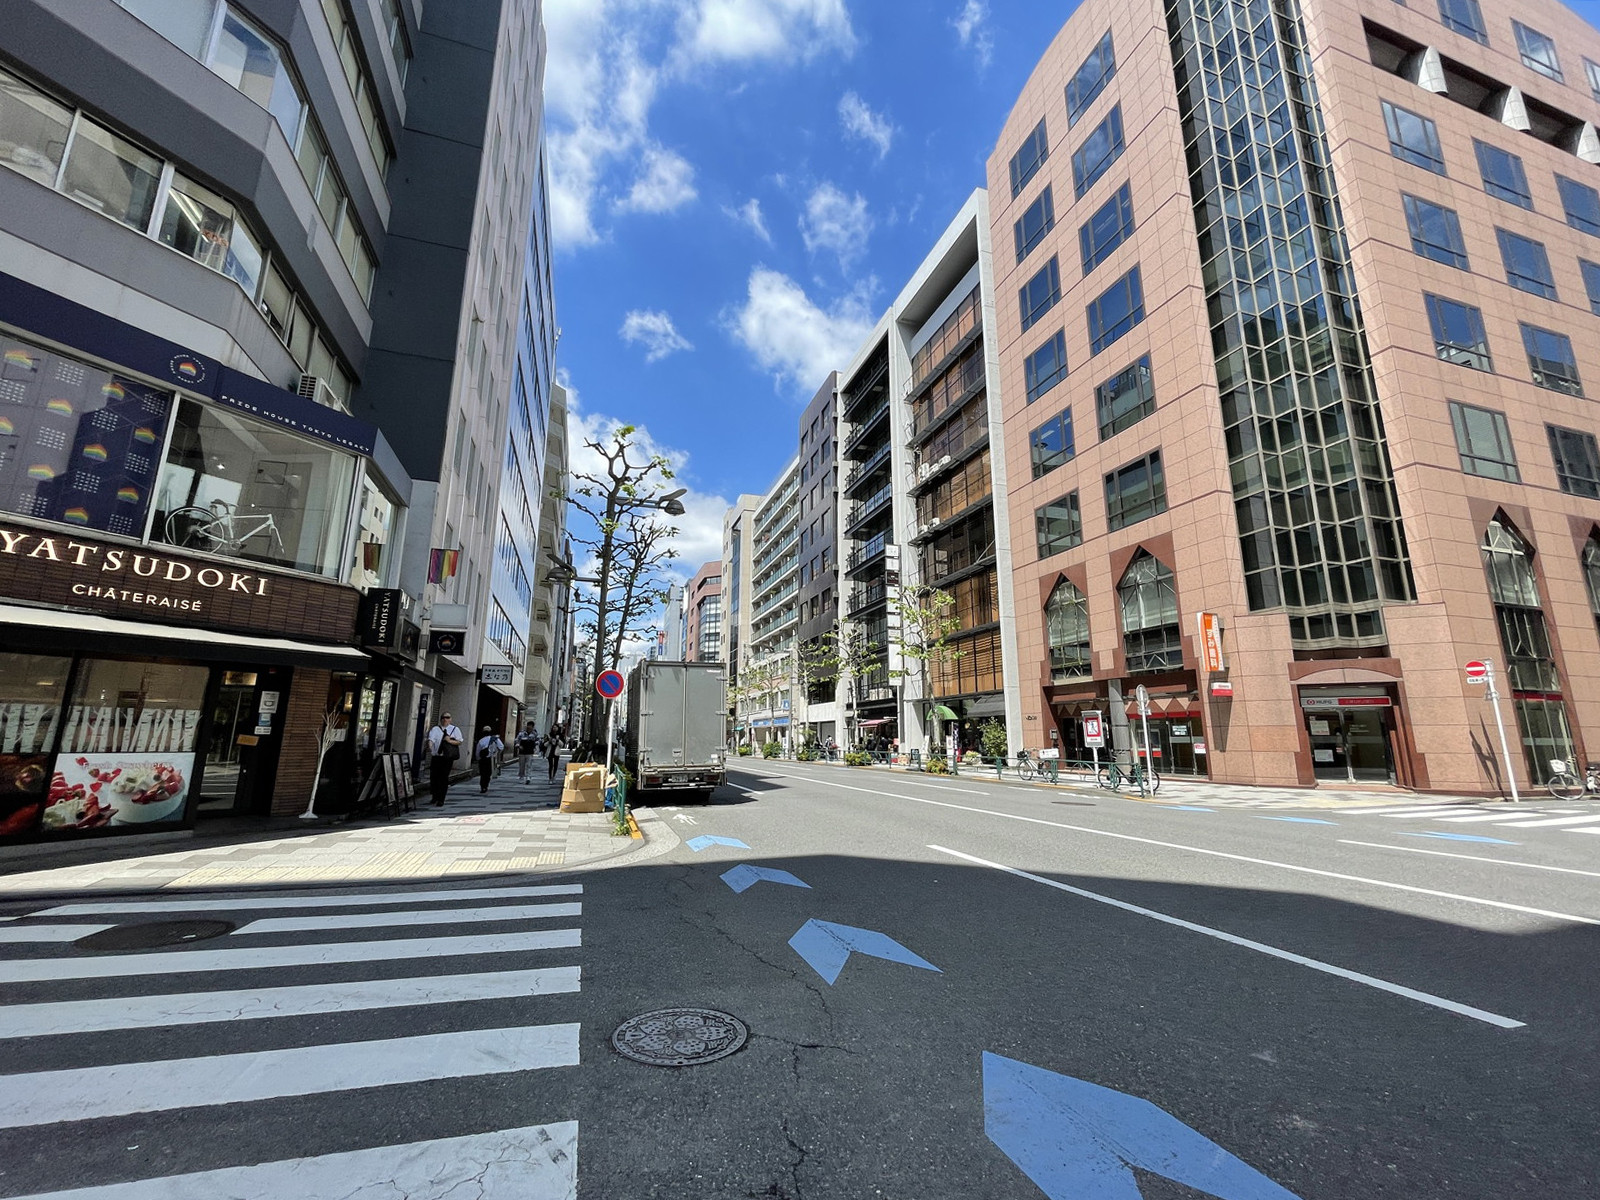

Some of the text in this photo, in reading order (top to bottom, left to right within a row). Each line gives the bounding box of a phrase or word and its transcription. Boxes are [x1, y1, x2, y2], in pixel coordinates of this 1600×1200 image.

[221, 395, 370, 452] PRIDE HOUSE TOKYO LEGACY
[0, 531, 269, 596] YATSUDOKI
[72, 584, 203, 611] CHÂTERAISÉ
[377, 591, 392, 643] YATSUDOKI
